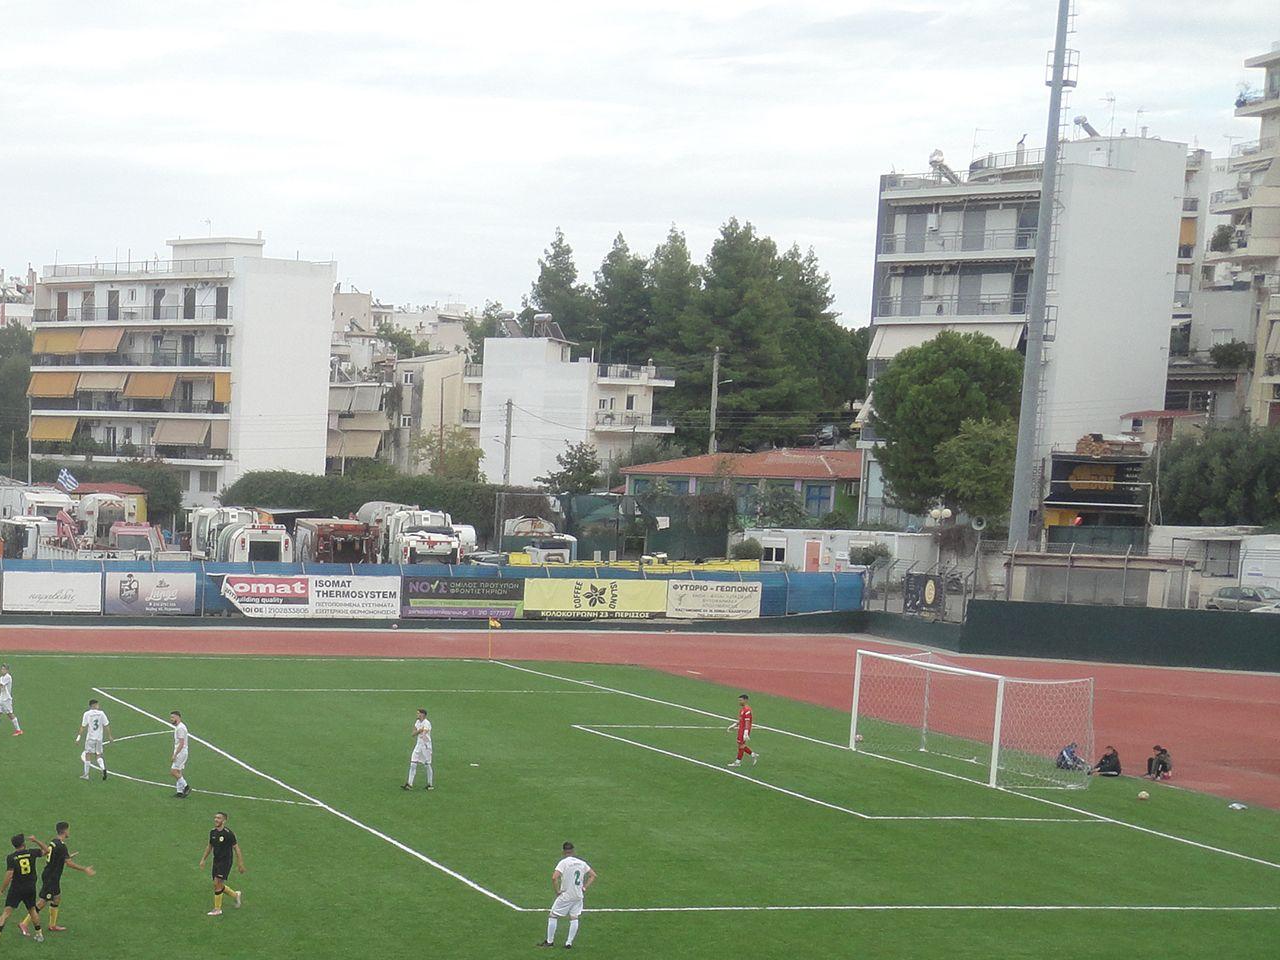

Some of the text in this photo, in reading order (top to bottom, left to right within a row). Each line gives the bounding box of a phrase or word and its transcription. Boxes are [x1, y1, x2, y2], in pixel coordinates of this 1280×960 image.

[314, 580, 352, 588] ISOMAT
[672, 584, 709, 592] ΦΥΤΩΡΙΟ
[715, 585, 759, 593] ΓΕΩΠΟΝΟΣ
[315, 590, 397, 599] THERMOSYSTEM
[573, 580, 583, 609] COFFEE
[608, 581, 618, 609] ISLAND
[92, 719, 99, 731] 3
[19, 858, 31, 875] 8
[574, 869, 581, 886] 2
